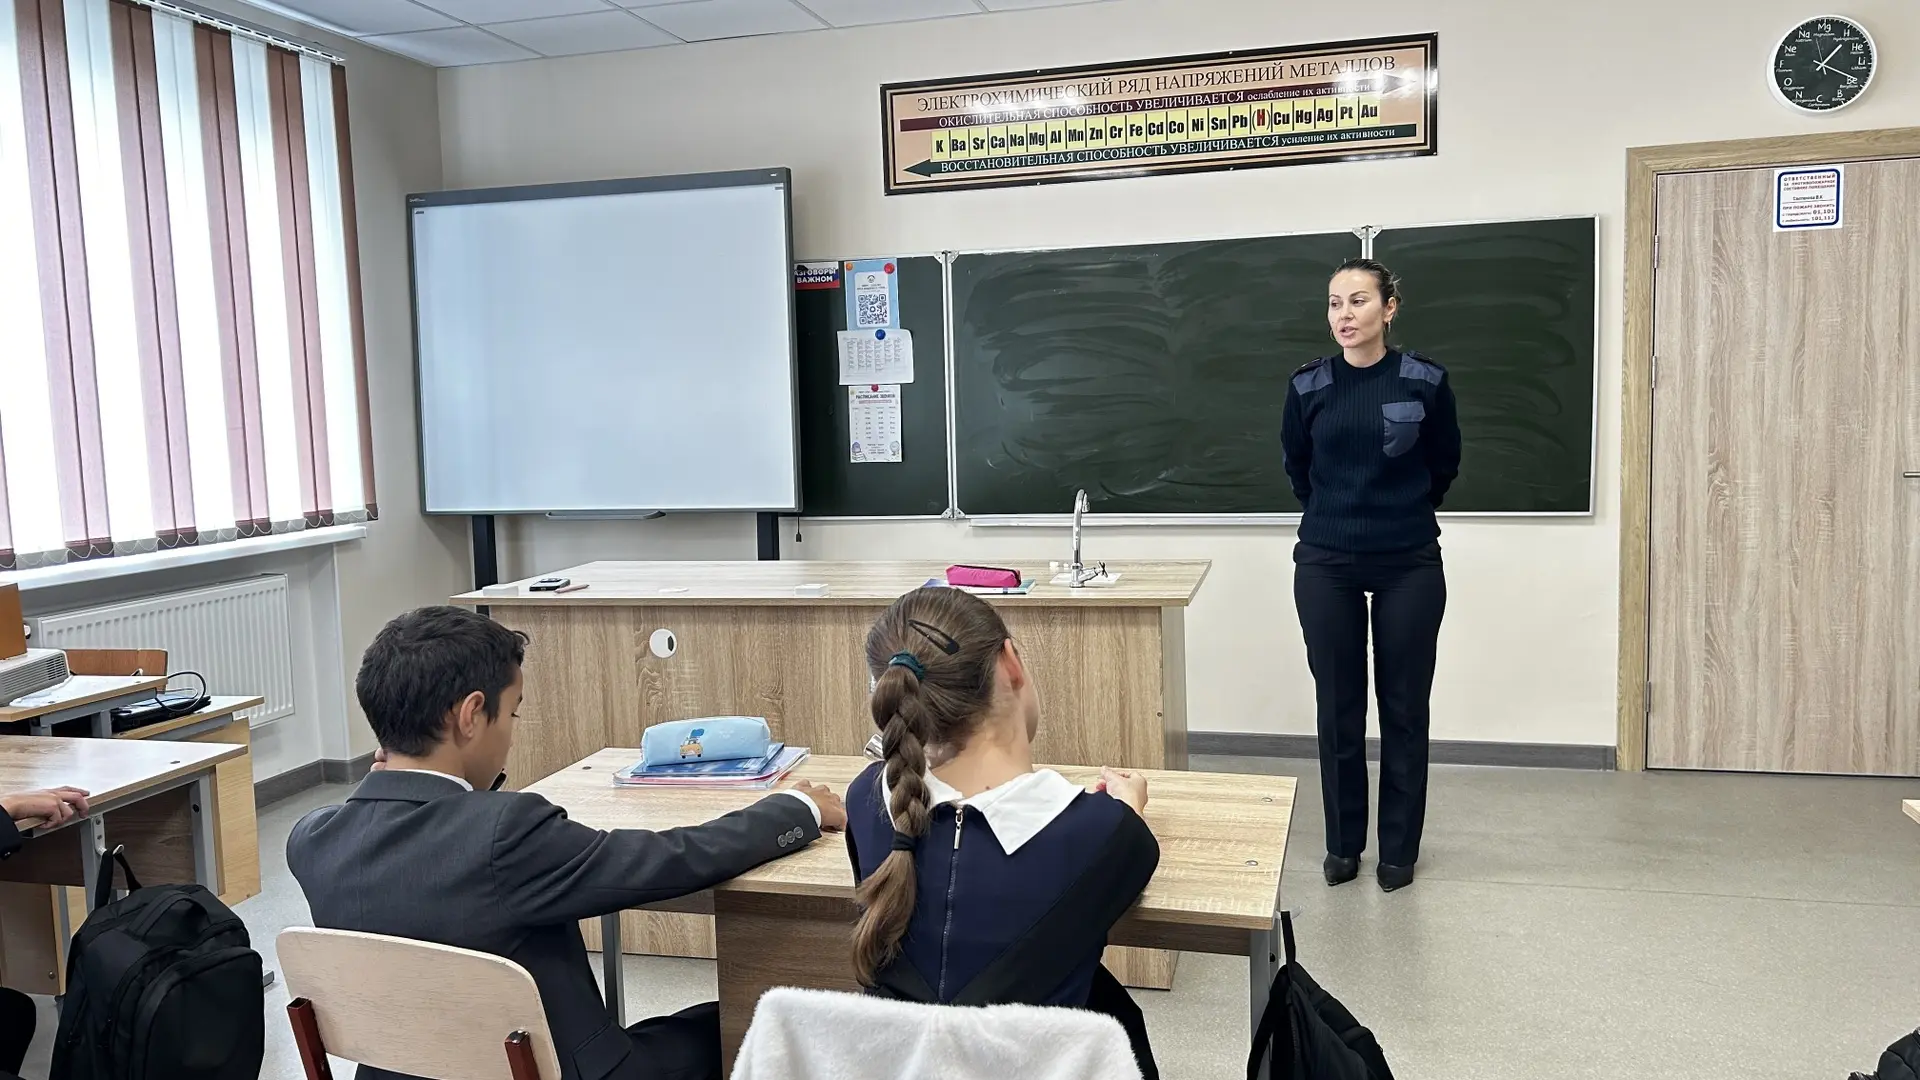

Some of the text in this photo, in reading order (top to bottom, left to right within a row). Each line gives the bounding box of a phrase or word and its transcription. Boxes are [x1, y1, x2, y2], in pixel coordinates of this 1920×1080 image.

[1818, 22, 1831, 32] Mg
[1798, 30, 1810, 38] Na
[1844, 29, 1850, 37] H
[1784, 45, 1797, 53] Ne
[1851, 42, 1863, 51] He
[1780, 60, 1784, 68] F
[1858, 56, 1866, 65] Li
[918, 56, 1396, 111] ЭЛЕКТРОХИМИЧЕСКИЙ РЯД НАПРЯЖЕНИЙ МЕТАЛЛОВ
[1784, 77, 1792, 86] O
[1837, 89, 1843, 97] B
[1816, 95, 1823, 103] C
[939, 84, 1370, 127] ОКИСЛИТЕЛЬНАЯ СПОСОБНОСТЬ УВЕЛИЧИВАЕТСЯ ослабление их активности
[936, 140, 944, 153] K
[951, 139, 966, 151] Ba
[973, 137, 985, 150] Sr
[990, 136, 1005, 148] Ca
[1010, 134, 1024, 147] Na
[1029, 132, 1045, 146] Mg
[1050, 130, 1061, 143] Al
[1068, 129, 1084, 142] Mn
[1089, 128, 1103, 140] Zn
[1109, 126, 1123, 139] Cr
[1129, 124, 1143, 136] Fe
[1148, 122, 1164, 135] Cd
[1168, 121, 1184, 133] Co
[1191, 118, 1204, 132] Ni
[1211, 117, 1227, 130] Sn
[1232, 115, 1248, 128] Pb
[1273, 112, 1290, 125] Cu
[1295, 110, 1312, 124] Hg
[1317, 108, 1333, 122] Ag
[1340, 106, 1353, 119] Pt
[1361, 105, 1378, 118] Au
[941, 129, 1395, 172] ВОССТАНОВИТЕЛЬНАЯ СПОСОБНОСТЬ УВЕЛИЧИВАЕТСЯ усиление их активности
[1783, 173, 1836, 182] ОТВЕТСТВЕННЫЙ
[794, 267, 836, 276] АЗГОВОРЫ
